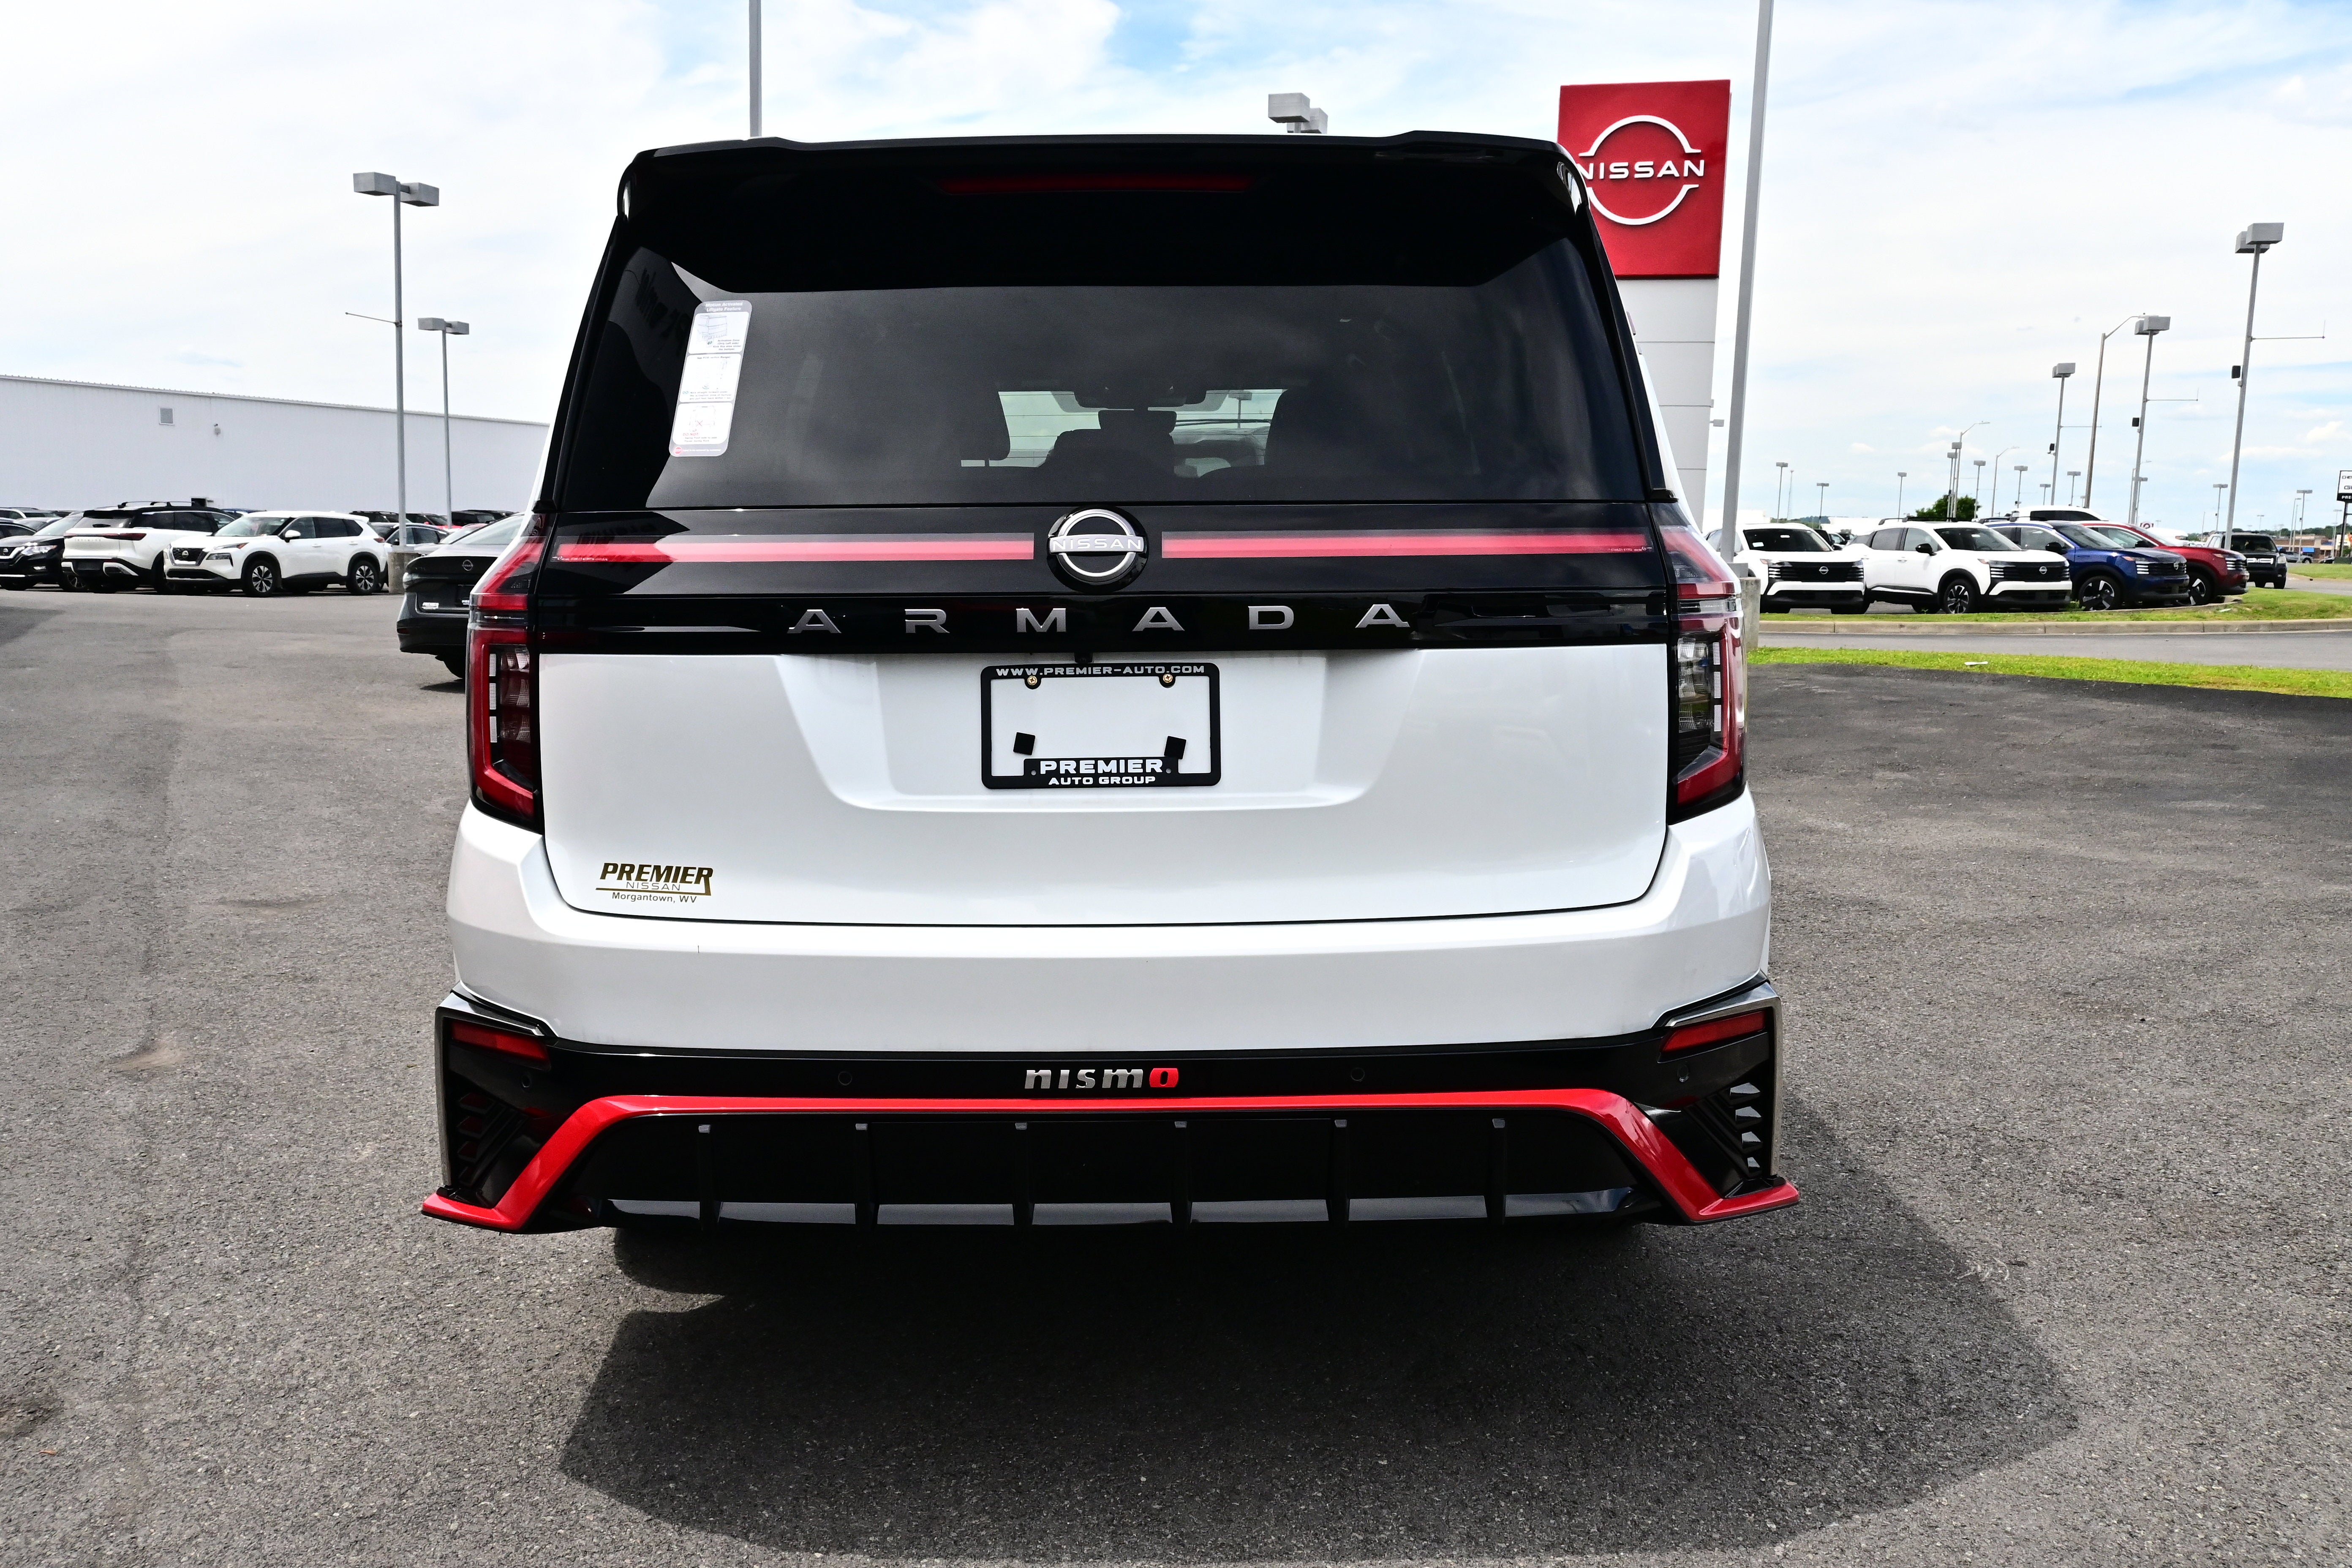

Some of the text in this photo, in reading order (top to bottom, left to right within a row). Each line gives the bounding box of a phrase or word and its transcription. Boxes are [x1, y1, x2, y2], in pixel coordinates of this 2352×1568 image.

[1576, 160, 1705, 180] NISSAN
[1053, 538, 1142, 551] NISSAN
[787, 604, 1410, 634] ARMADA
[996, 665, 1205, 676] WWW.PREMIER-AUTO.COM
[1040, 759, 1163, 775] PREMIER
[1048, 776, 1156, 786] AUTO GROUP
[599, 862, 714, 886] PREMIER
[626, 882, 681, 891] NISSAN
[612, 892, 697, 904] Morgantown, WV
[1024, 1067, 1179, 1089] nismo
